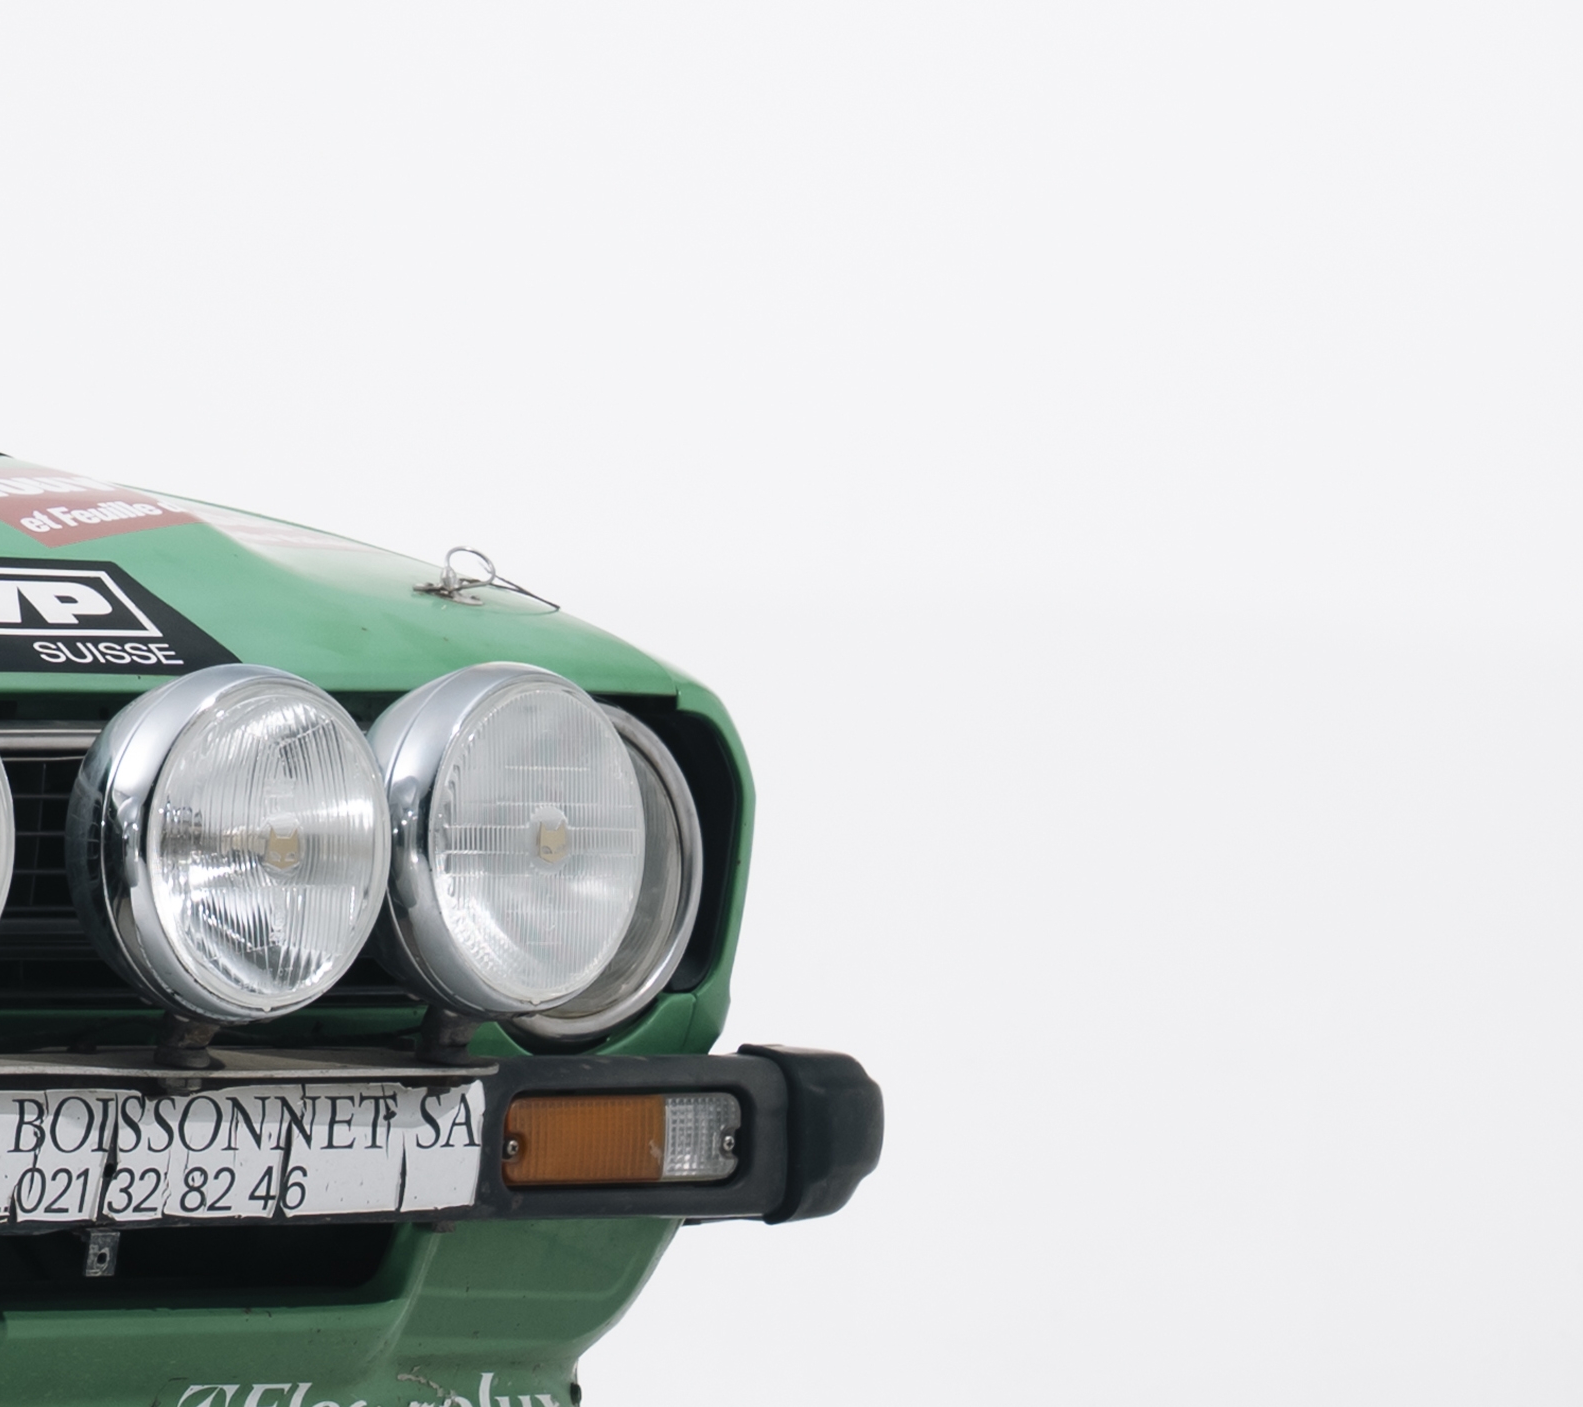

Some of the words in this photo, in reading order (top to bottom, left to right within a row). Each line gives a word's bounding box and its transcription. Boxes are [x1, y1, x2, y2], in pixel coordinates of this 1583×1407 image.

[20, 510, 59, 533] et
[48, 501, 162, 527] Feuille
[32, 641, 184, 666] SUISSE
[8, 1094, 399, 1153] BOISSONNET
[416, 1093, 483, 1150] SA
[180, 1166, 235, 1212] 82
[249, 1165, 306, 1210] 46
